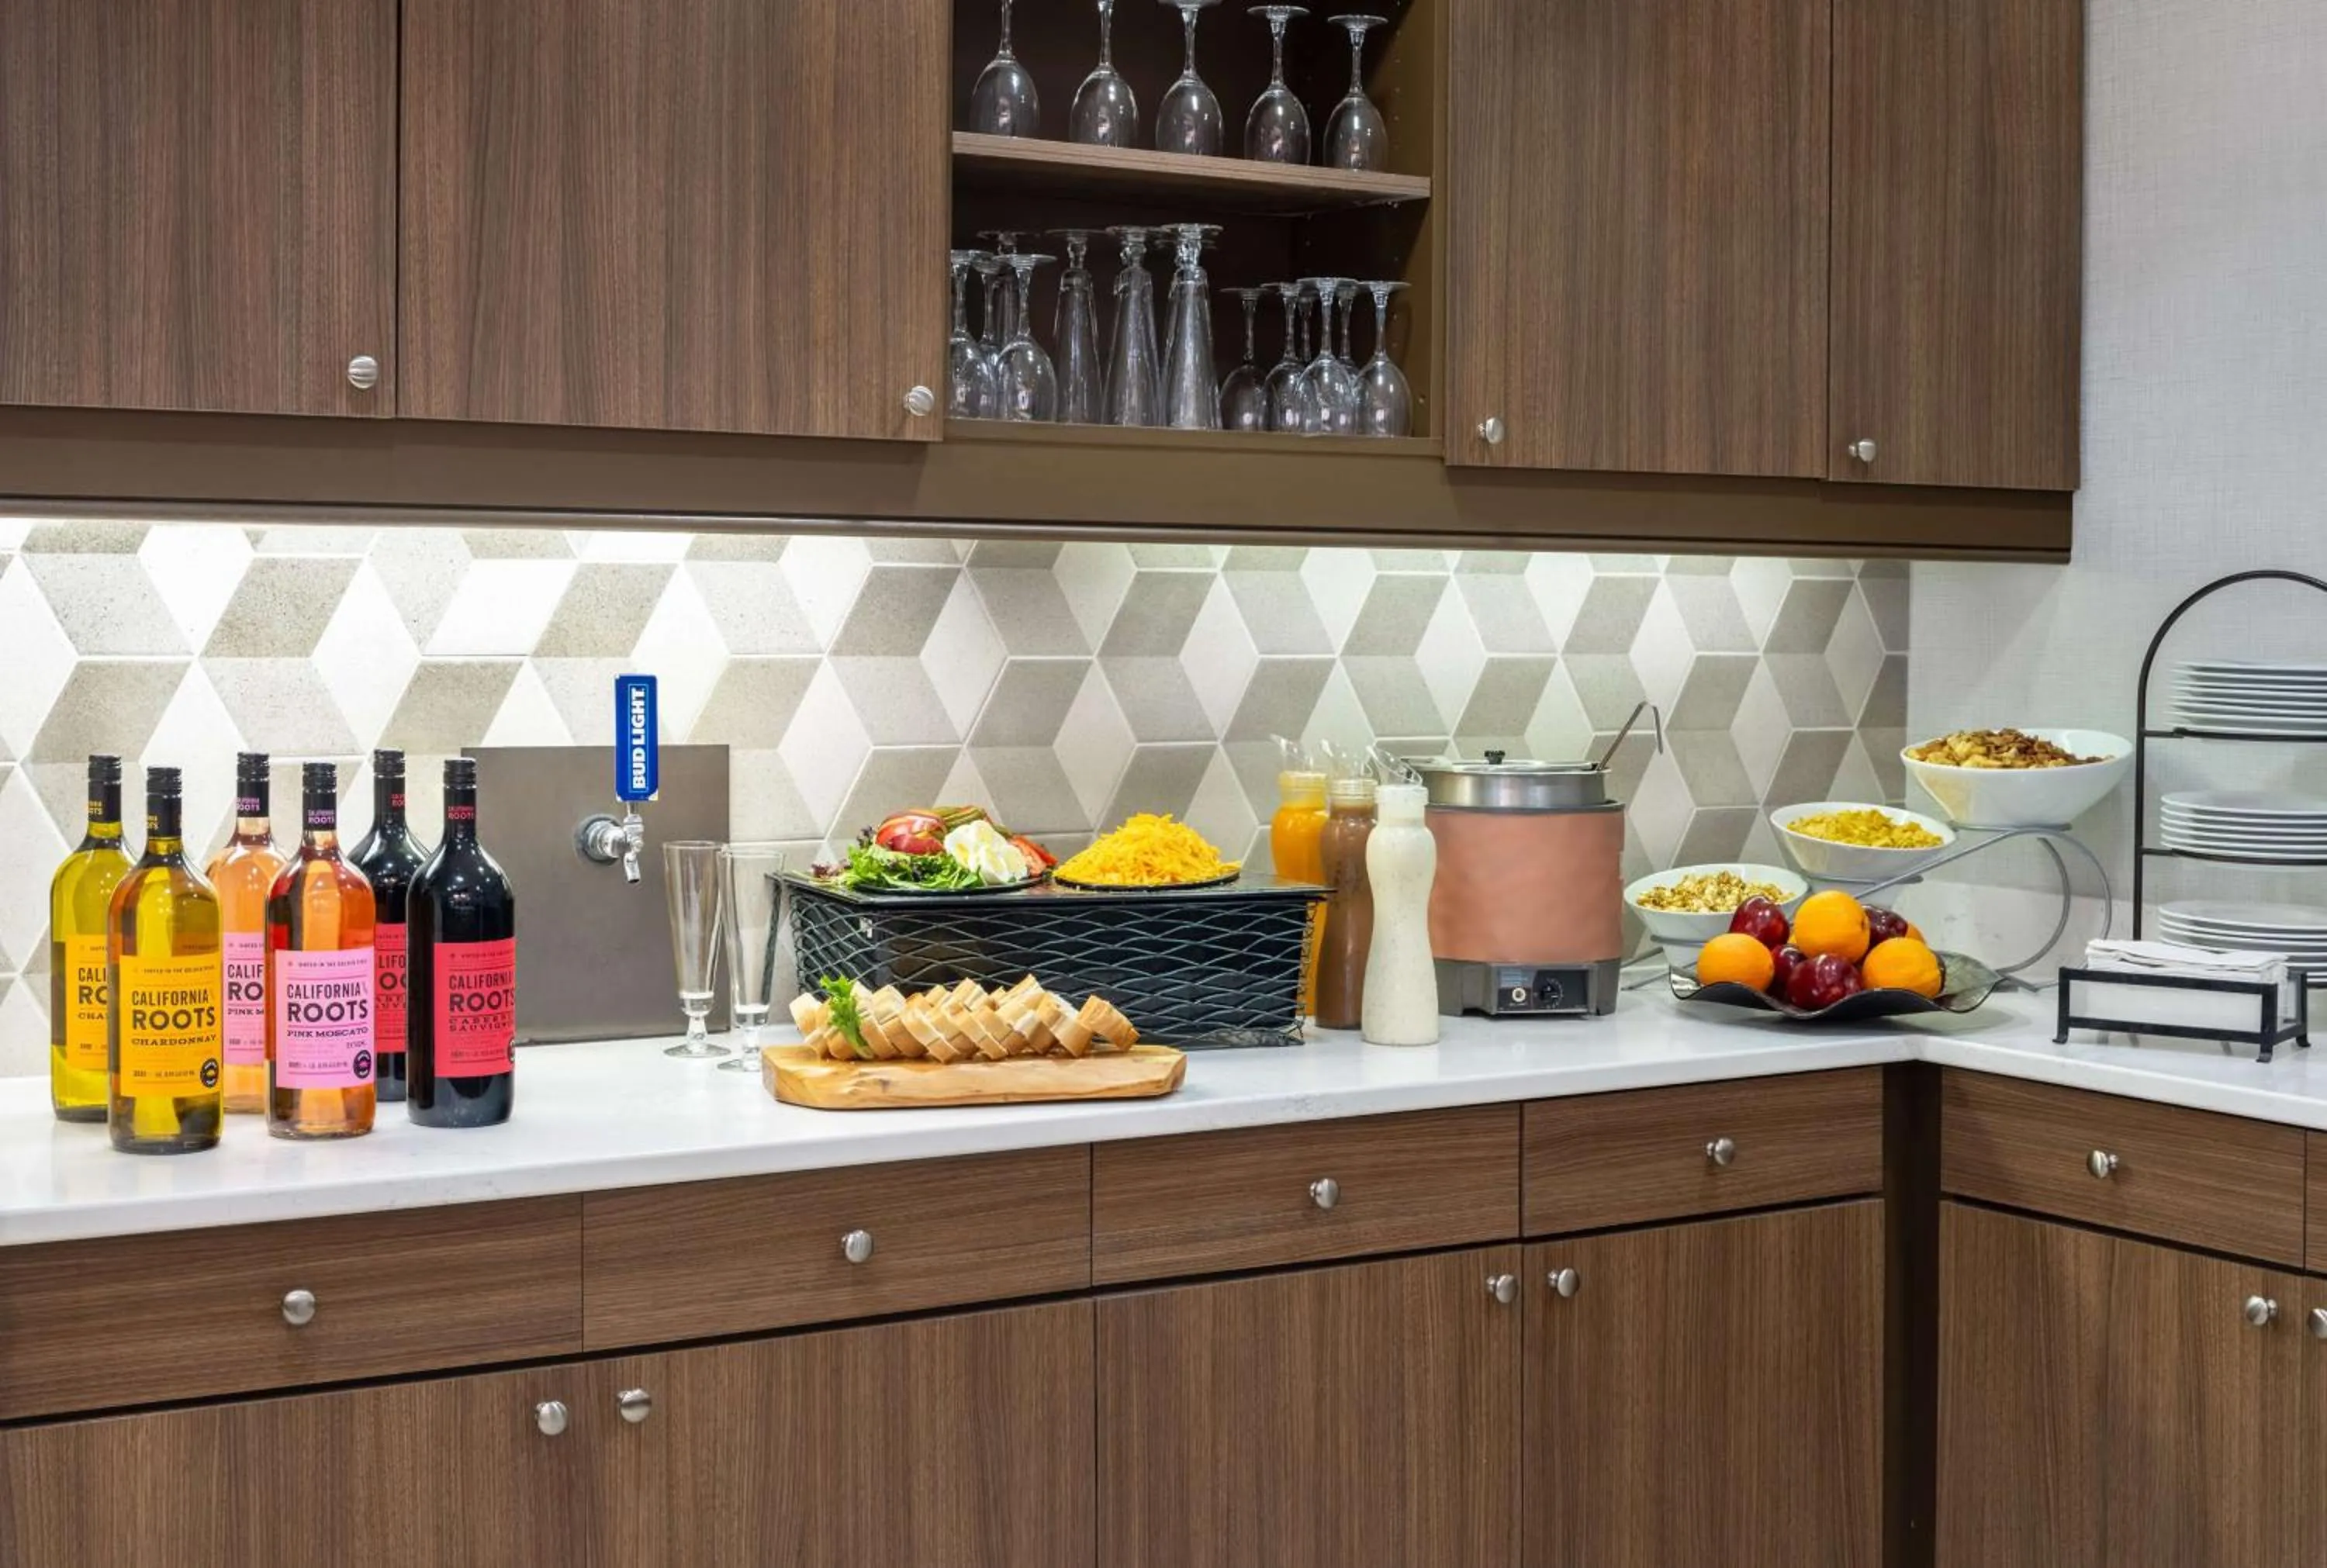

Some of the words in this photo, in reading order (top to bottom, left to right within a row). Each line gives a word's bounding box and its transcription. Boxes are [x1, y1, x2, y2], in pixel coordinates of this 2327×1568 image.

[631, 687, 646, 745] LIGHT
[632, 747, 646, 789] BUD
[227, 964, 265, 979] CALIF
[132, 988, 209, 1007] CALIFORNIA
[287, 982, 361, 1000] CALIFORNIA
[449, 988, 515, 1013] ROOTS
[133, 1007, 216, 1031] ROOTS
[287, 999, 368, 1023] ROOTS
[132, 1034, 216, 1046] CHARDONNAY
[287, 1029, 313, 1038] PINK
[316, 1026, 368, 1038] MOSCATO
